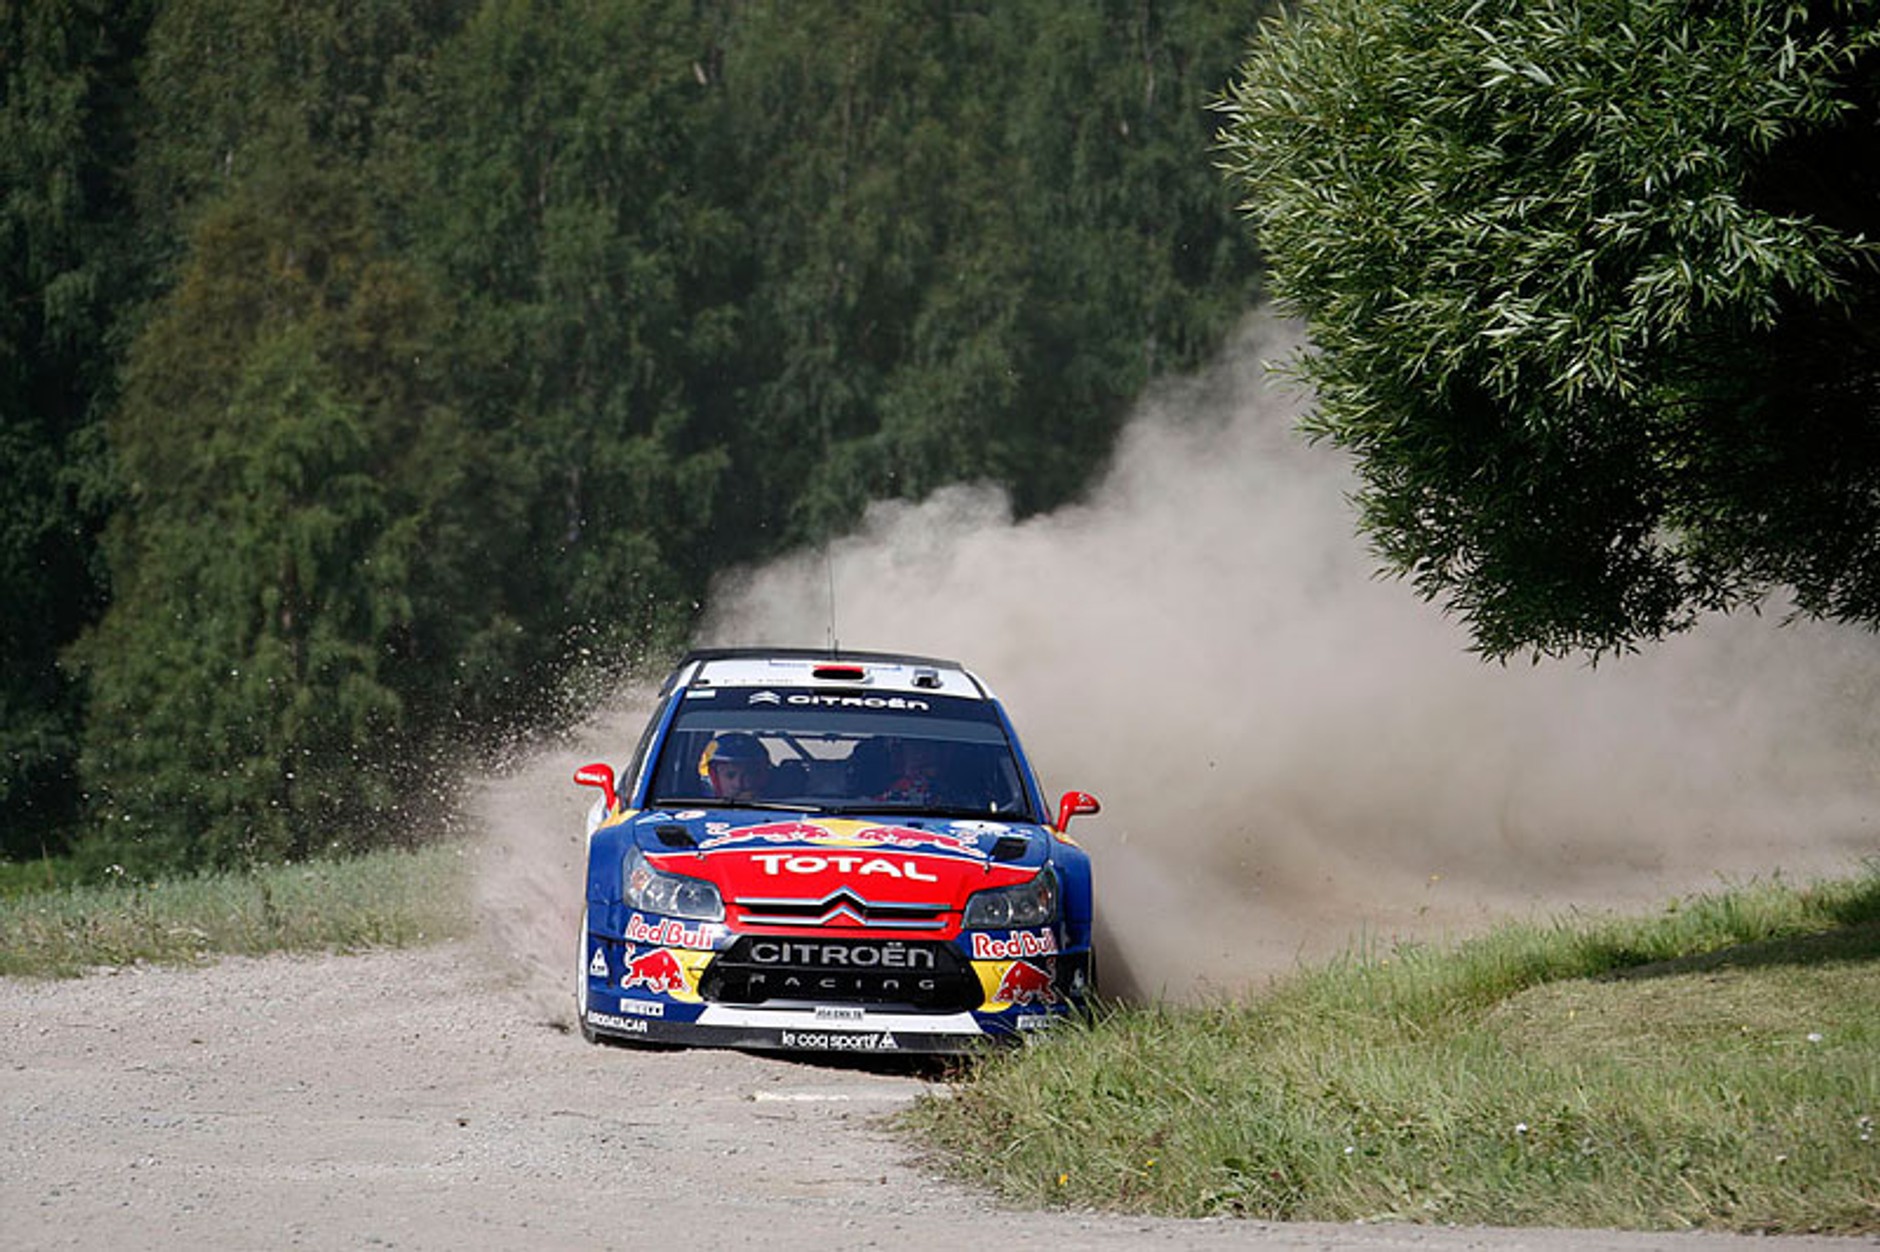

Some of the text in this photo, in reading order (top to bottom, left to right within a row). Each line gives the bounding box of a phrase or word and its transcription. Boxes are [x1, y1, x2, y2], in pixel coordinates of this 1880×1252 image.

[751, 853, 938, 882] TOTAL
[626, 913, 713, 948] Red Bull
[751, 942, 935, 968] CITROËN
[972, 931, 1022, 959] Red
[750, 973, 935, 990] RACING
[782, 1030, 880, 1051] le coq sportif
